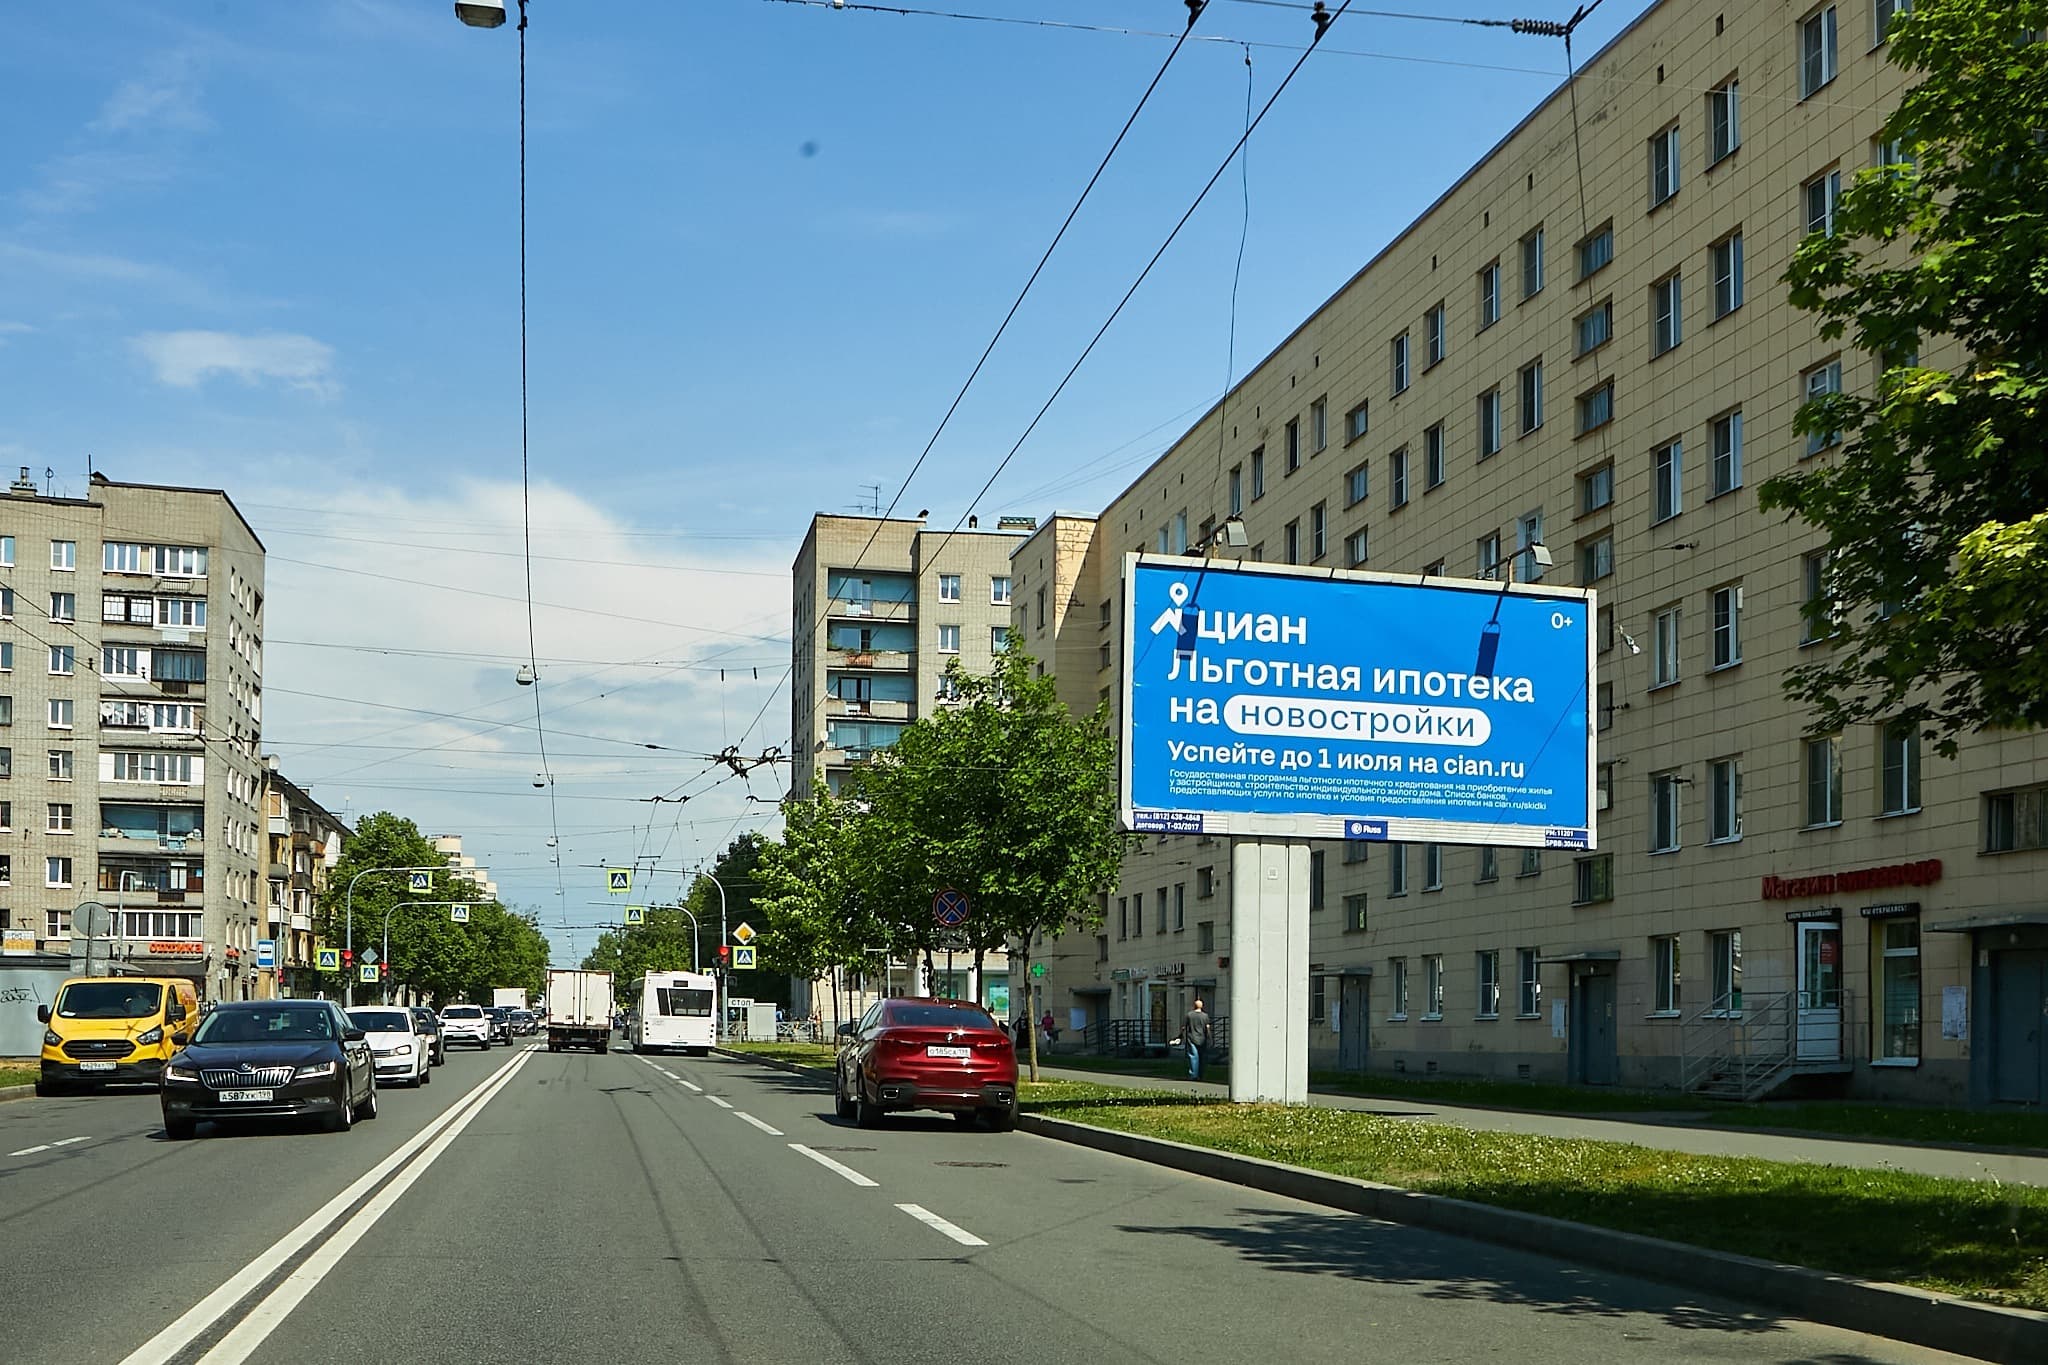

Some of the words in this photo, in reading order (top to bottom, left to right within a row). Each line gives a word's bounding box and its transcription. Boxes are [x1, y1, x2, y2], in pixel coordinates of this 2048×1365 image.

[1197, 609, 1307, 645] циан
[1551, 612, 1573, 629] 0+
[1167, 648, 1361, 691] Льготная
[1373, 667, 1535, 703] ипотека
[1169, 698, 1219, 725] на
[1240, 704, 1474, 739] новостройки
[1167, 740, 1276, 766] Успейте
[1279, 749, 1313, 770] до
[1317, 748, 1332, 769] 1
[1337, 753, 1402, 772] июля
[1408, 756, 1439, 774] на
[1443, 755, 1525, 778] cian.ru
[1762, 875, 1838, 900] Магазин
